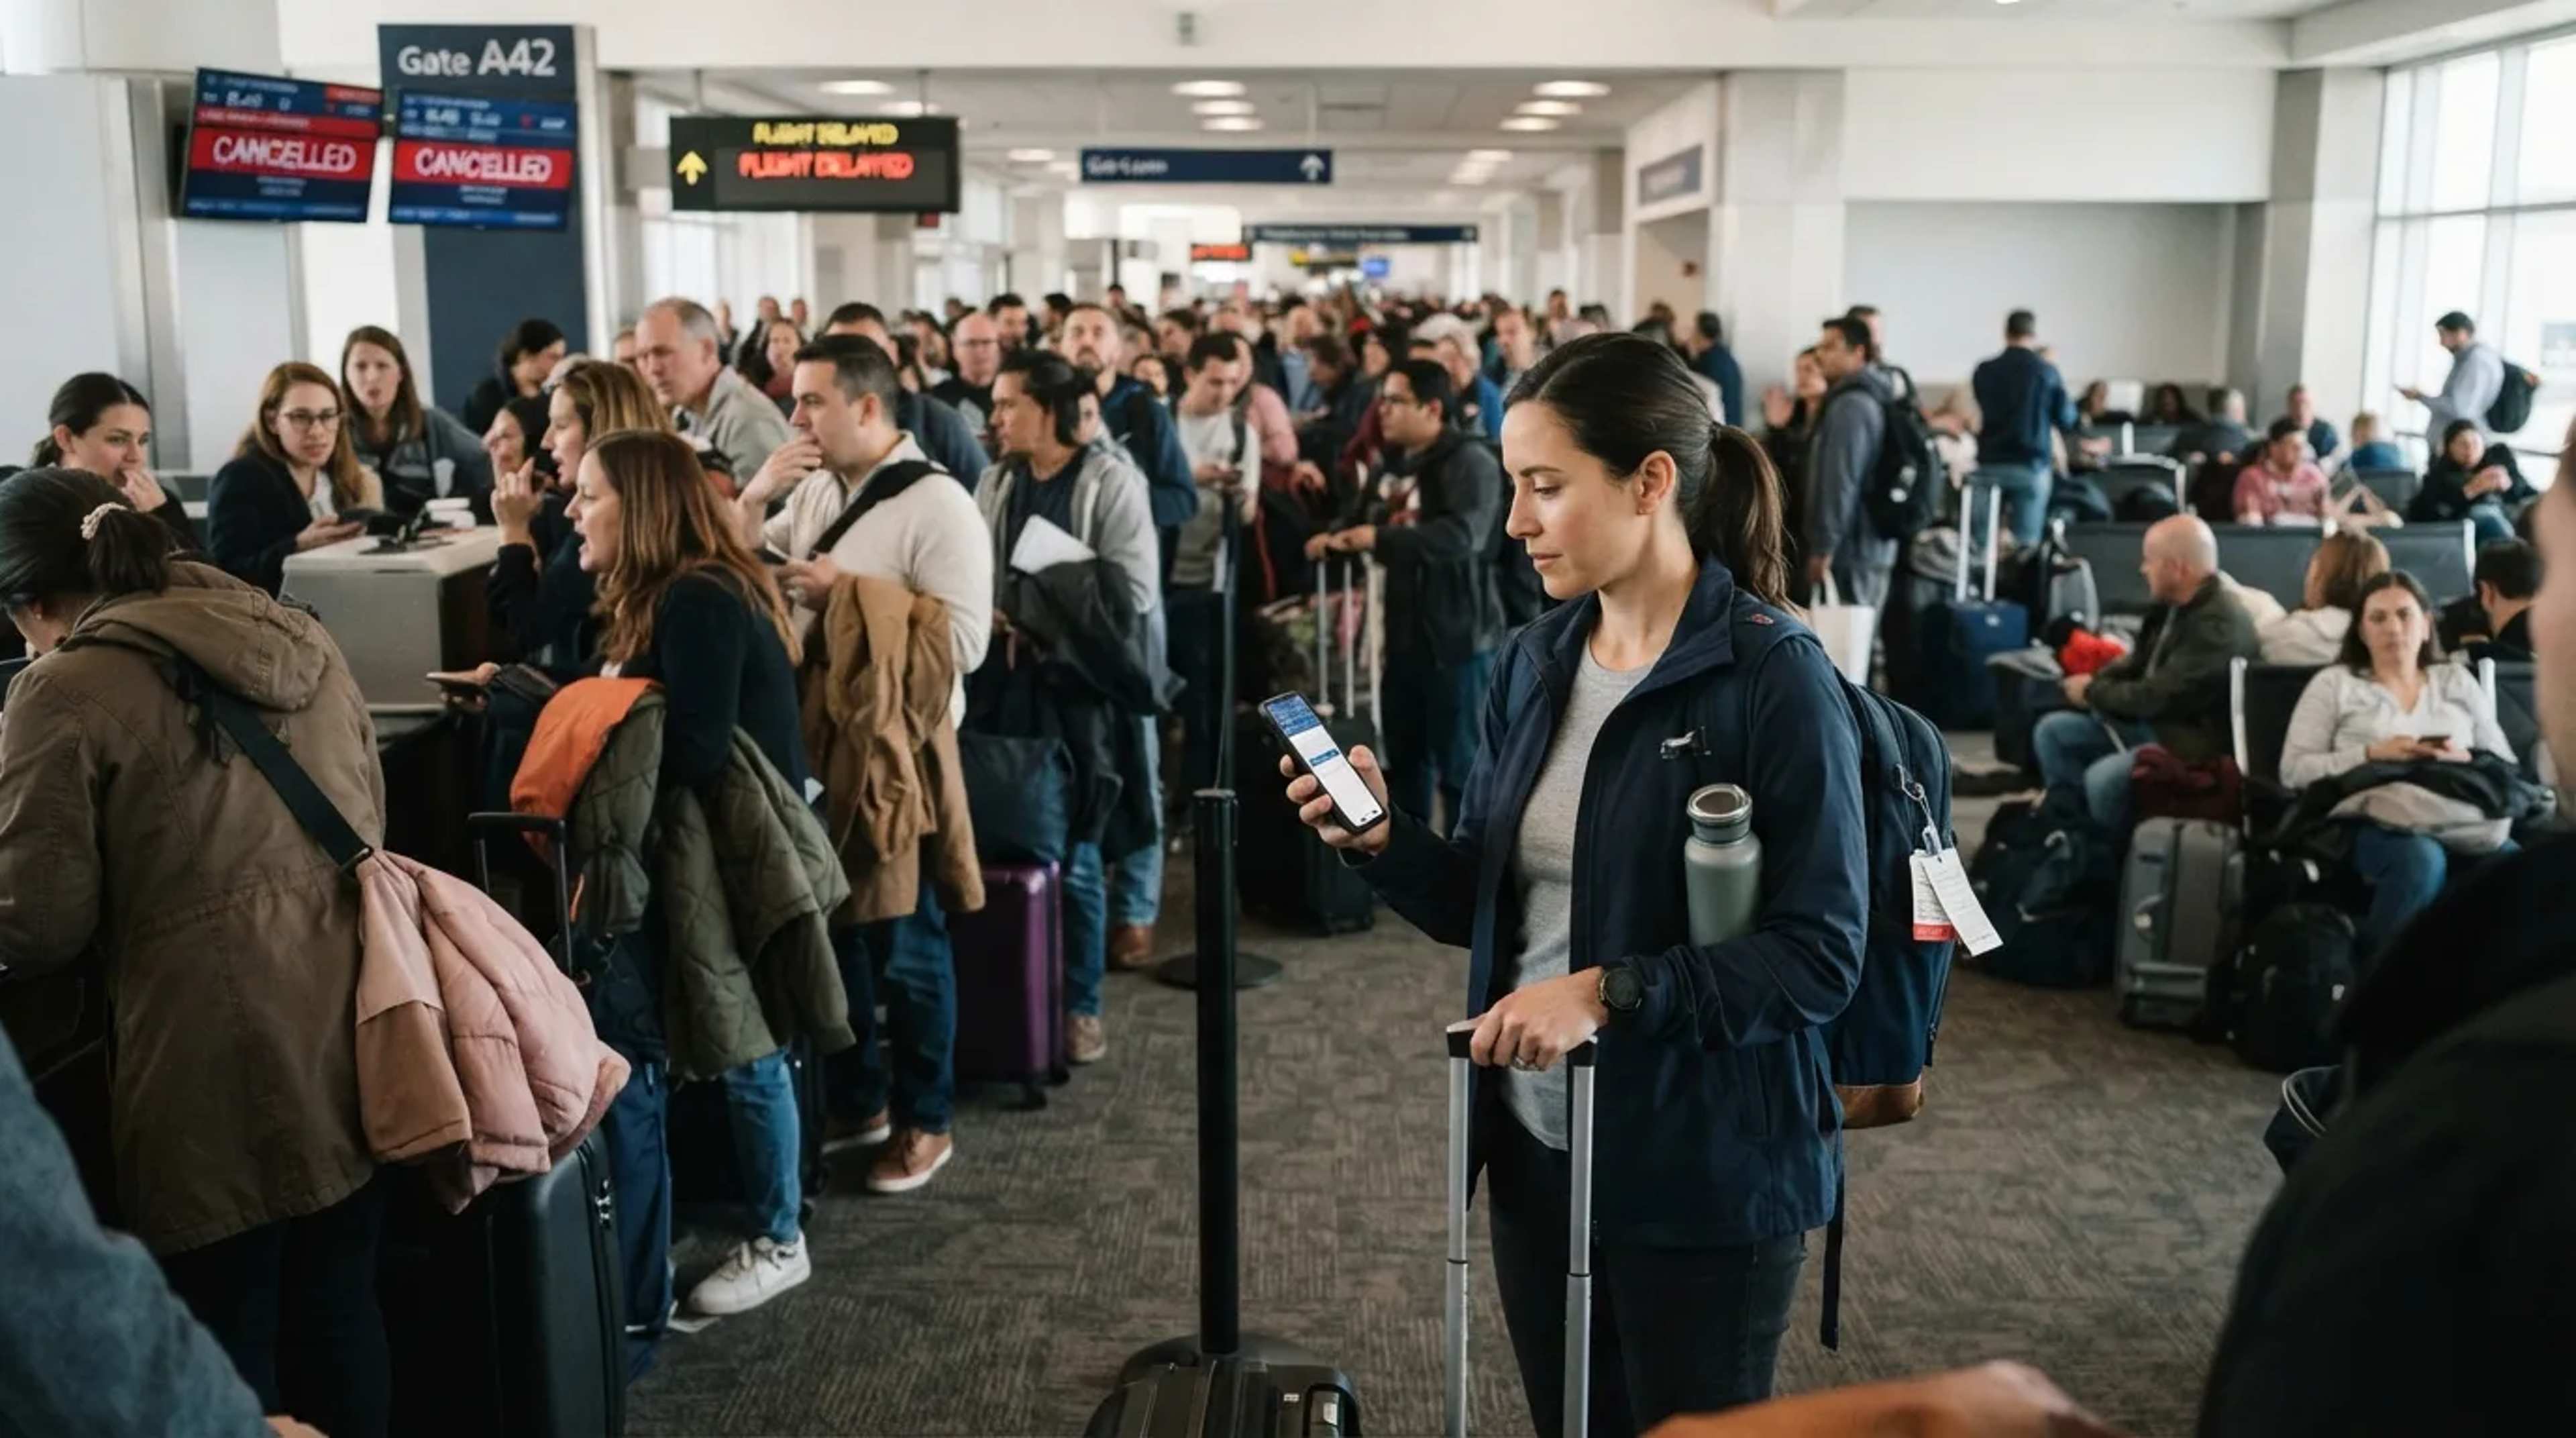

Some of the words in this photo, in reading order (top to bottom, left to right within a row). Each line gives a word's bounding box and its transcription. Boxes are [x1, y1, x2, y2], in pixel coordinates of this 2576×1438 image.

[397, 45, 471, 76] Gate
[477, 38, 556, 76] A42
[213, 136, 357, 172] CANCELLED
[415, 147, 552, 183] CANCELLED
